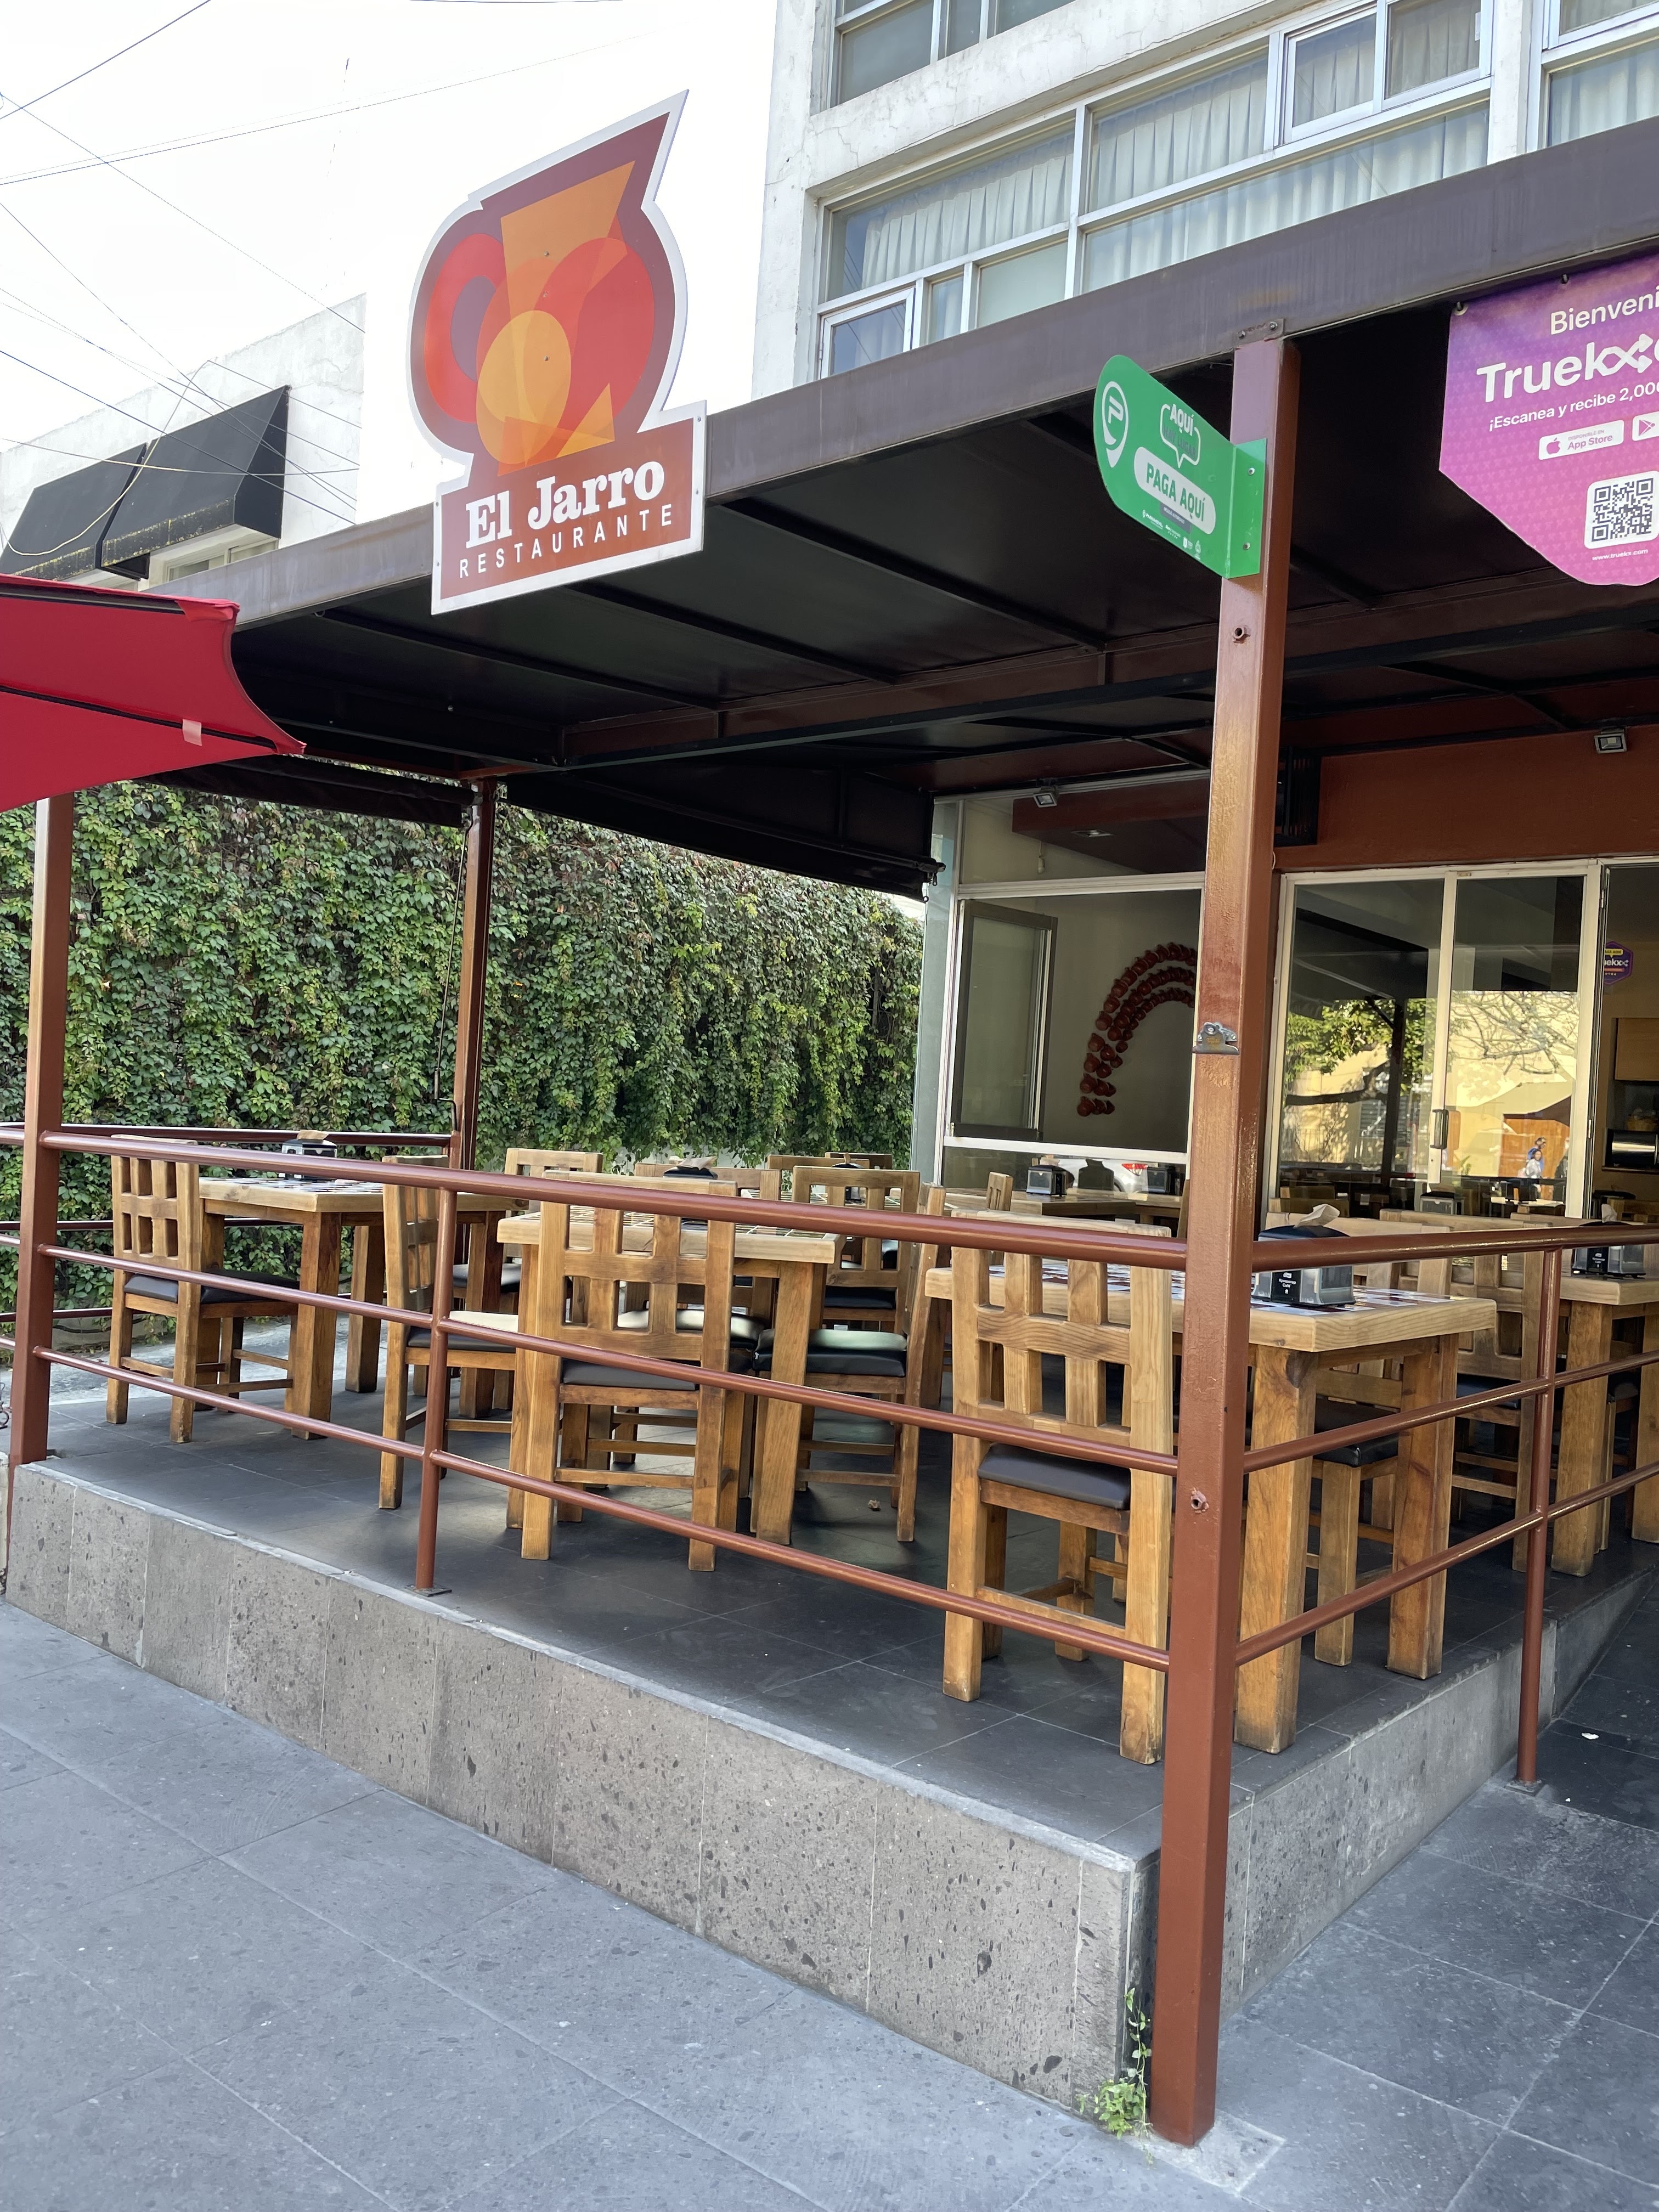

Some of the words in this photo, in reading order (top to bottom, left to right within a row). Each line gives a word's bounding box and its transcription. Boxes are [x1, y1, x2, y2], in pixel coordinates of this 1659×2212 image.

[1170, 403, 1194, 437] AQUÍ
[1489, 407, 1555, 432] ¡Escanea
[1558, 404, 1567, 419] y
[1570, 393, 1616, 413] recibe
[1619, 381, 1659, 402] 2,00
[1567, 441, 1587, 450] App
[1588, 435, 1613, 445] Store
[465, 490, 512, 549] El
[527, 461, 665, 530] Jarro
[1146, 462, 1176, 502] PAGA
[1180, 487, 1205, 522] AQUÍ
[459, 504, 672, 579] RESTAURANTE
[1592, 549, 1649, 561] www.truekx.com
